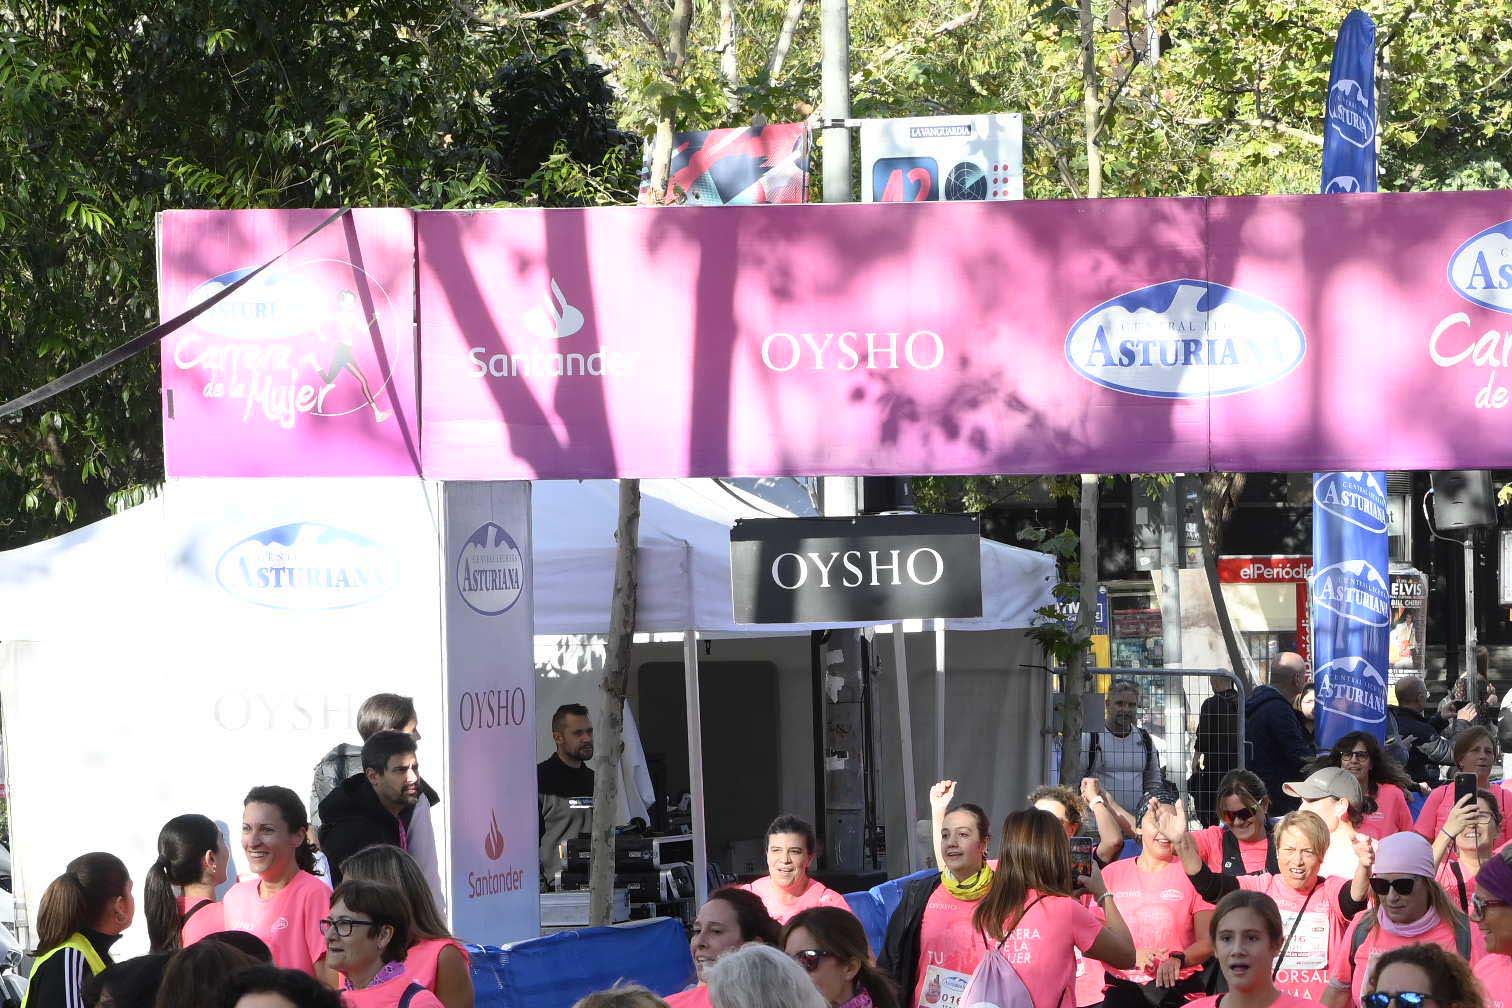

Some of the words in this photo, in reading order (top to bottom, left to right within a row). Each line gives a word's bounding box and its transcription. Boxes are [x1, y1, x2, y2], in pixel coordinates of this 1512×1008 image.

[468, 346, 640, 377] Santander
[761, 331, 945, 373] OYSHO
[243, 370, 336, 431] Mujer
[1474, 371, 1508, 410] de
[461, 559, 520, 592] ASTURIANA
[771, 547, 945, 590] OYSHO
[1391, 582, 1422, 596] ELVIS
[459, 686, 526, 731] OYSHO
[468, 866, 524, 899] Santander
[927, 951, 945, 967] TU
